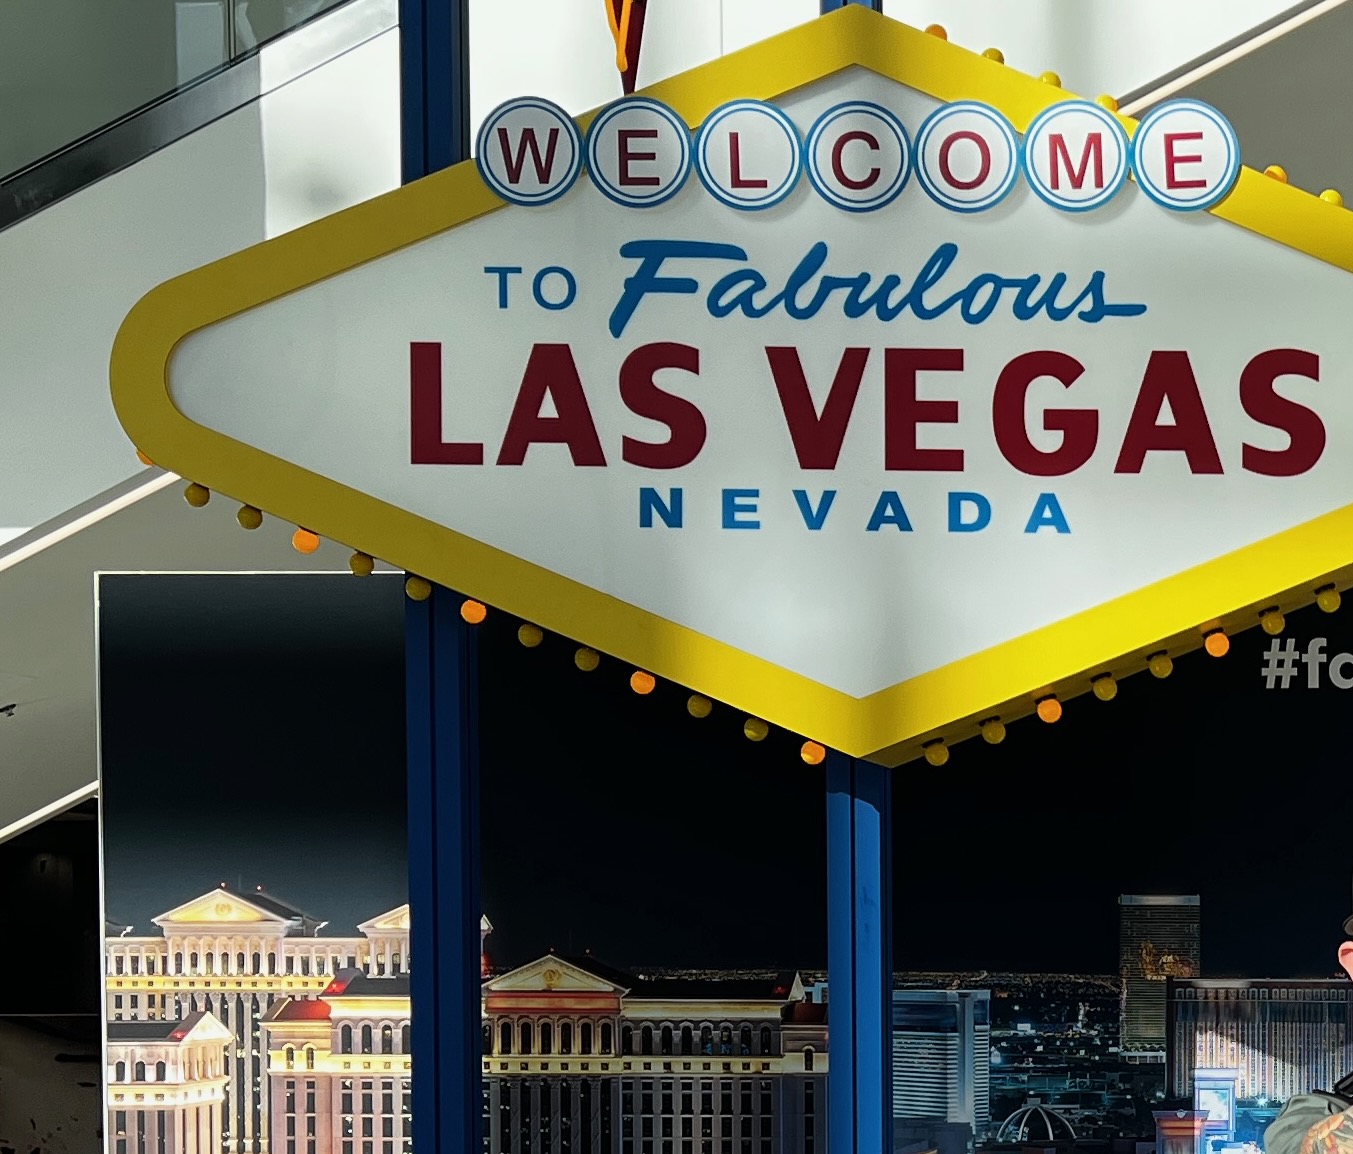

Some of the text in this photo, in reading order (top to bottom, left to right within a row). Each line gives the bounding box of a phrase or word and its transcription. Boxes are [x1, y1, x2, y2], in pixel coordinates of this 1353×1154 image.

[496, 126, 1207, 191] WELCOME
[484, 239, 1147, 339] TO Fabulous
[410, 341, 1327, 478] LAS VEGAS
[639, 486, 1072, 535] NEVADA
